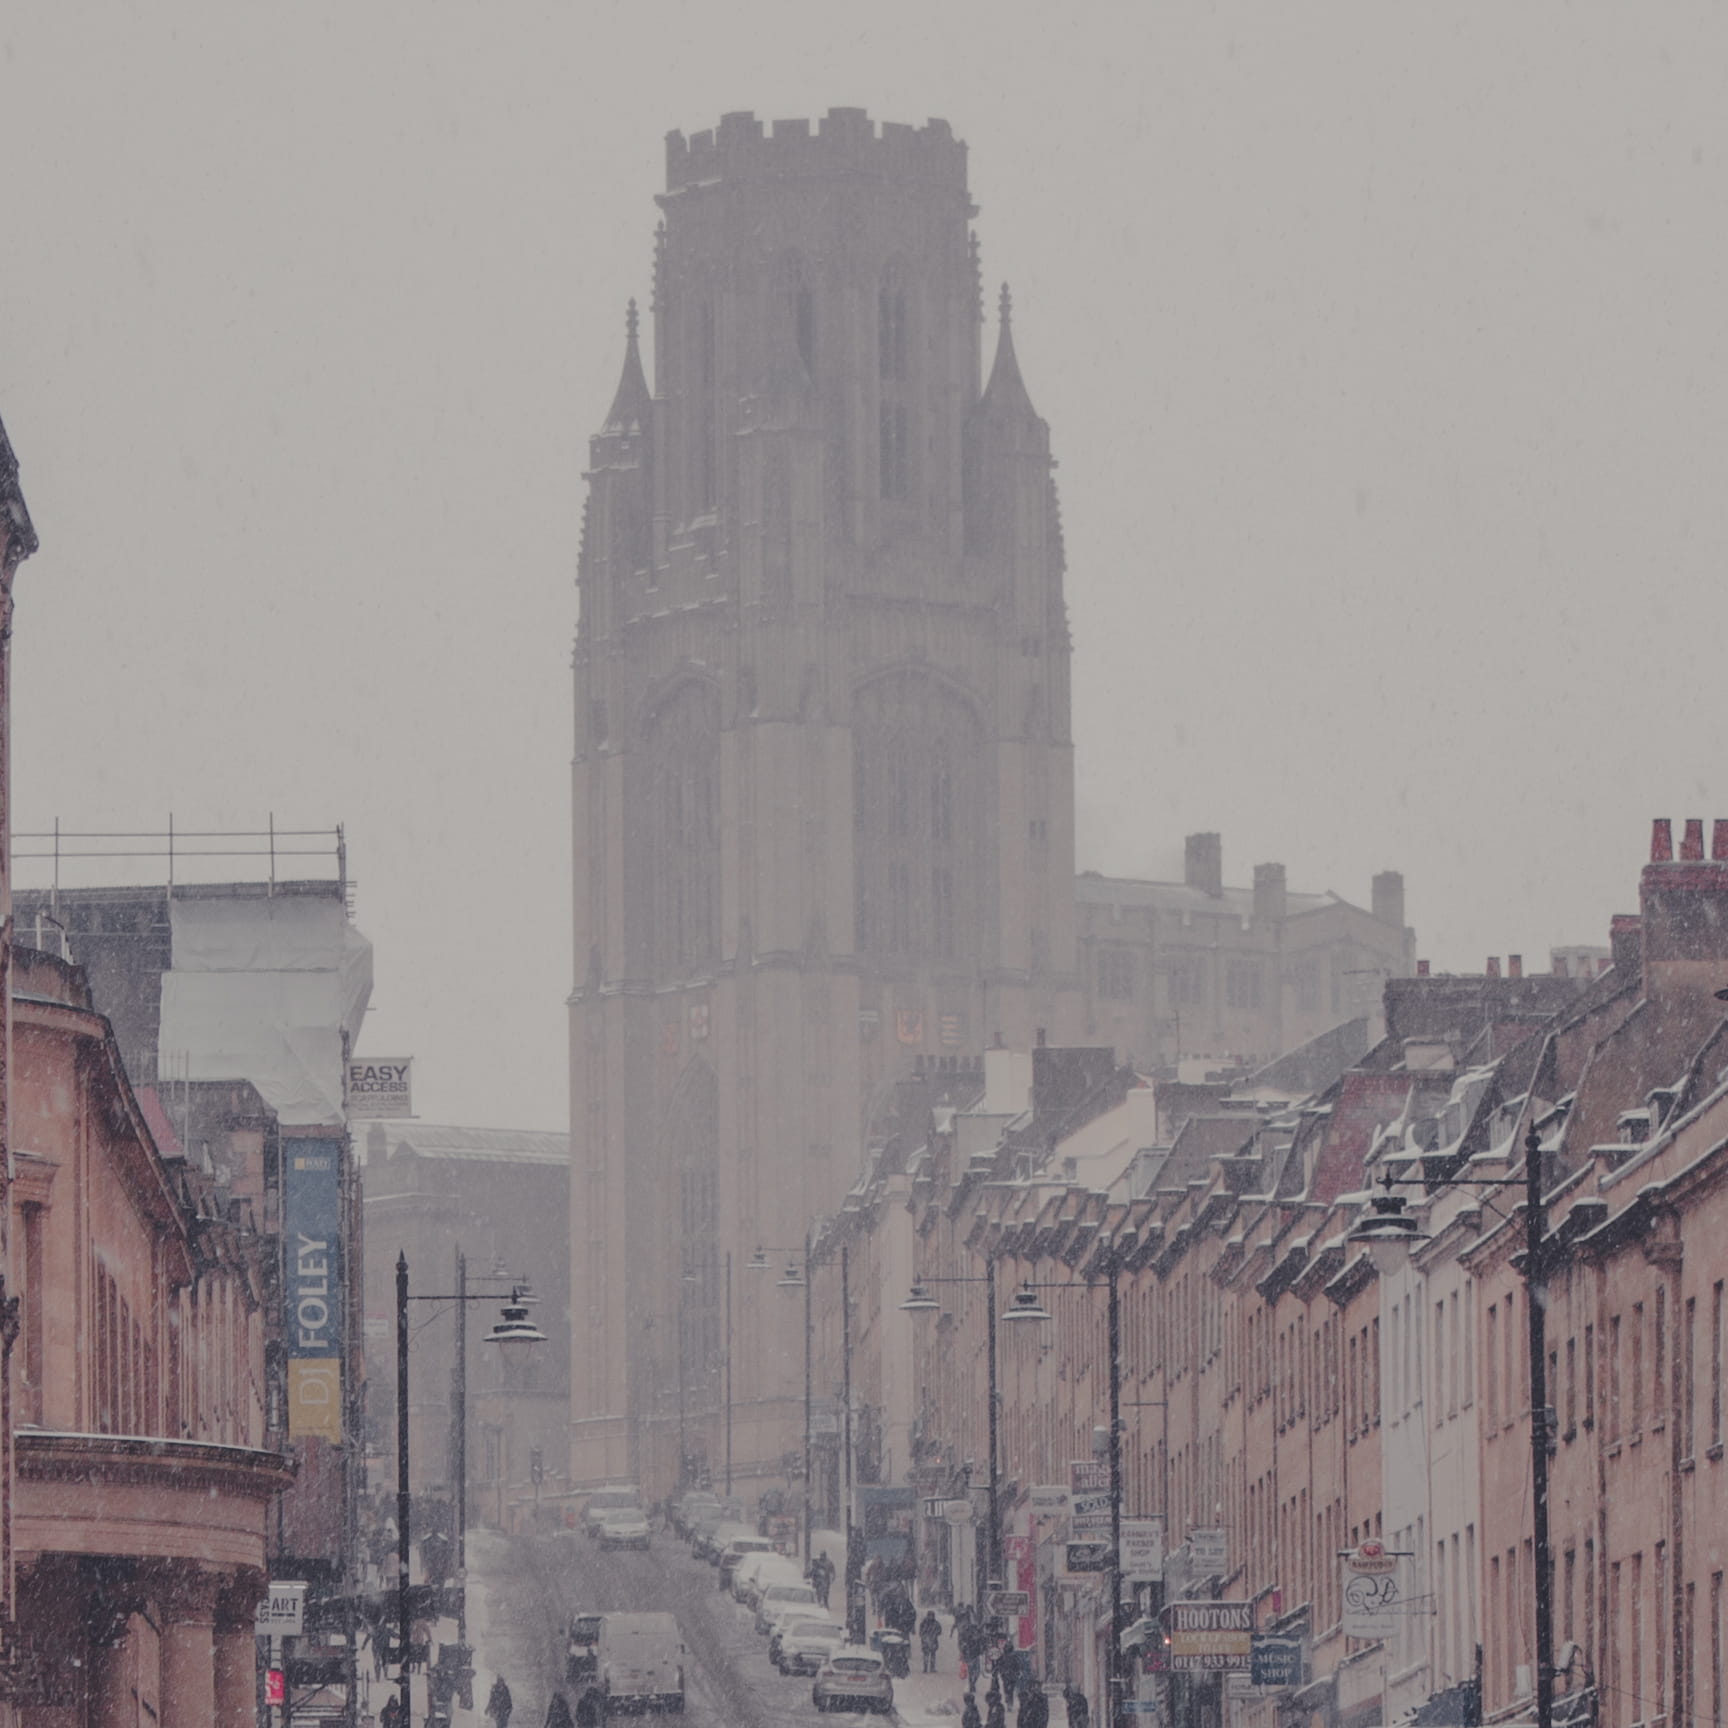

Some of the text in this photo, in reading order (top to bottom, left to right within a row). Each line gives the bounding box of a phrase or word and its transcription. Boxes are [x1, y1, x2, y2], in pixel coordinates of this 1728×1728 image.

[350, 1065, 408, 1081] EASY
[350, 1082, 408, 1093] ACCESS
[297, 1232, 329, 1348] FOLEY
[272, 1598, 298, 1612] ART
[1177, 1608, 1250, 1629] HOOTONS
[1175, 1656, 1201, 1669] 0117
[1204, 1655, 1224, 1668] 933
[1258, 1654, 1295, 1664] MUSIC
[1261, 1668, 1292, 1678] SHOP
